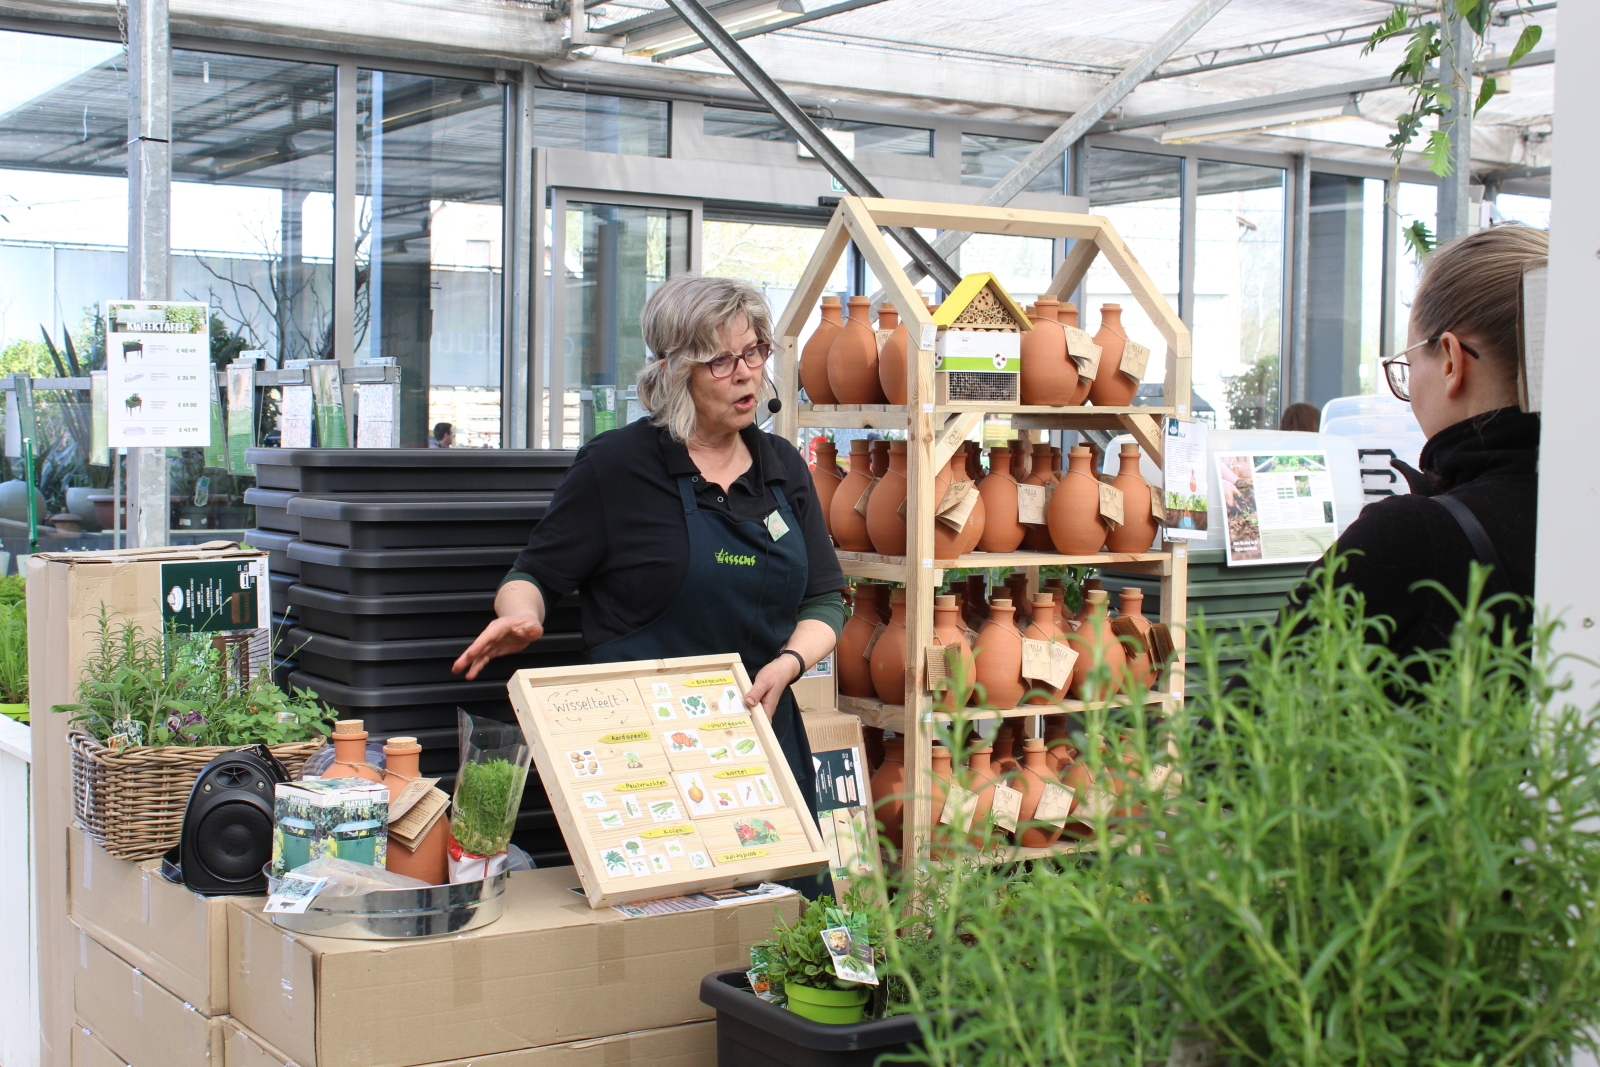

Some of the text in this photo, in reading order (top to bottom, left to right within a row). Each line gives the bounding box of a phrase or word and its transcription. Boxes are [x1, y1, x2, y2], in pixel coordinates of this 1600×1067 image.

[126, 321, 190, 332] KWEEKTAFELS
[625, 780, 667, 789] Peulvruchten
[290, 795, 310, 807] NATURE
[345, 799, 373, 808] NATURE
